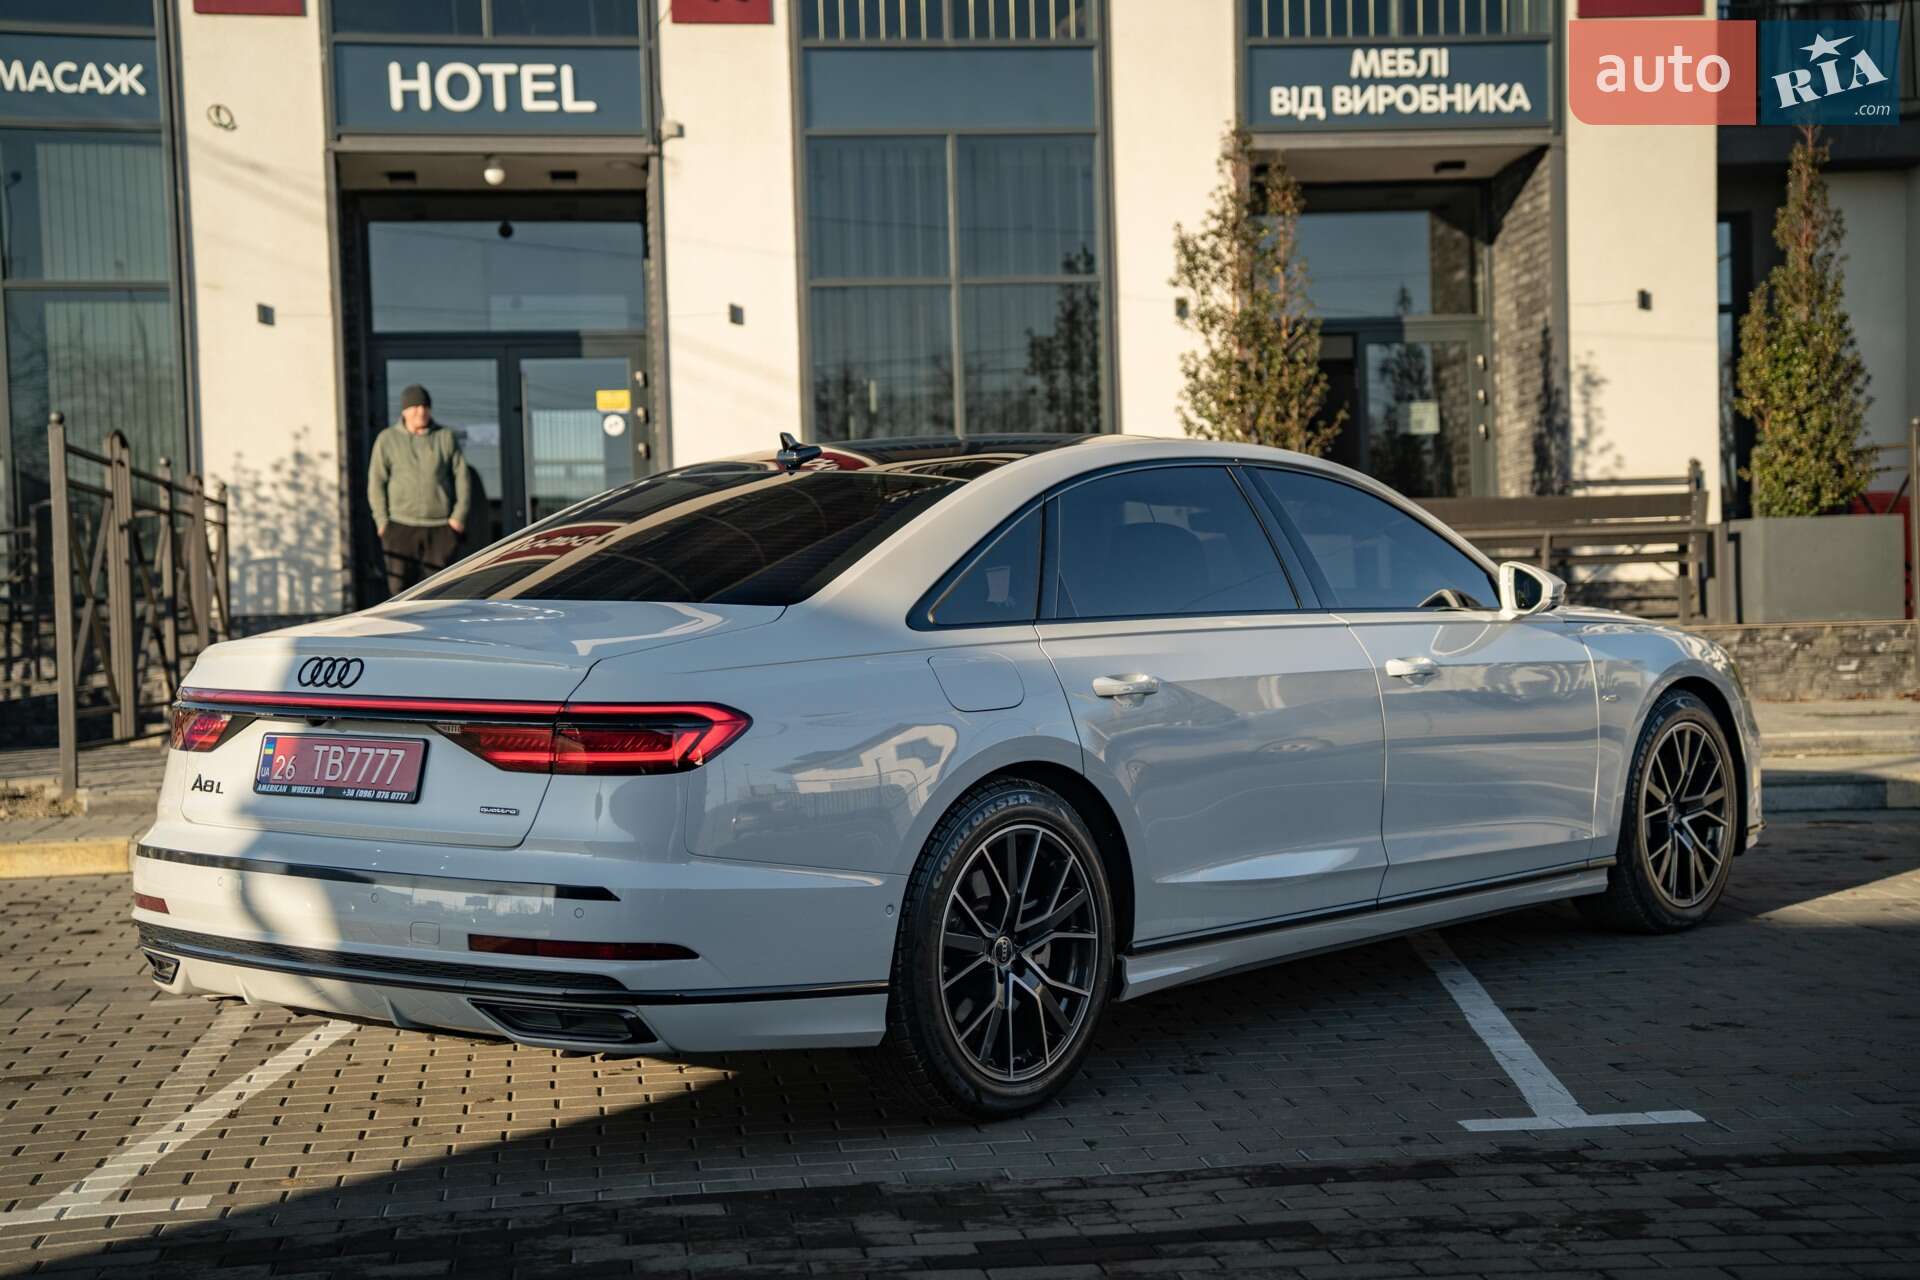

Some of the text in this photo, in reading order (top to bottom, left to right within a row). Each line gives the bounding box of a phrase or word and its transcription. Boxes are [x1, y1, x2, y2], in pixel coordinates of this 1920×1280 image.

[0, 59, 147, 96] МАСАЖ
[1350, 47, 1449, 79] МЕБЛІ
[387, 60, 598, 113] HOTEL
[1269, 81, 1532, 121] ВІД ВИРОБНИКА
[260, 767, 270, 777] UA
[272, 745, 406, 786] 26 TB7777
[191, 773, 224, 794] A8L
[256, 783, 288, 793] AMERICAN
